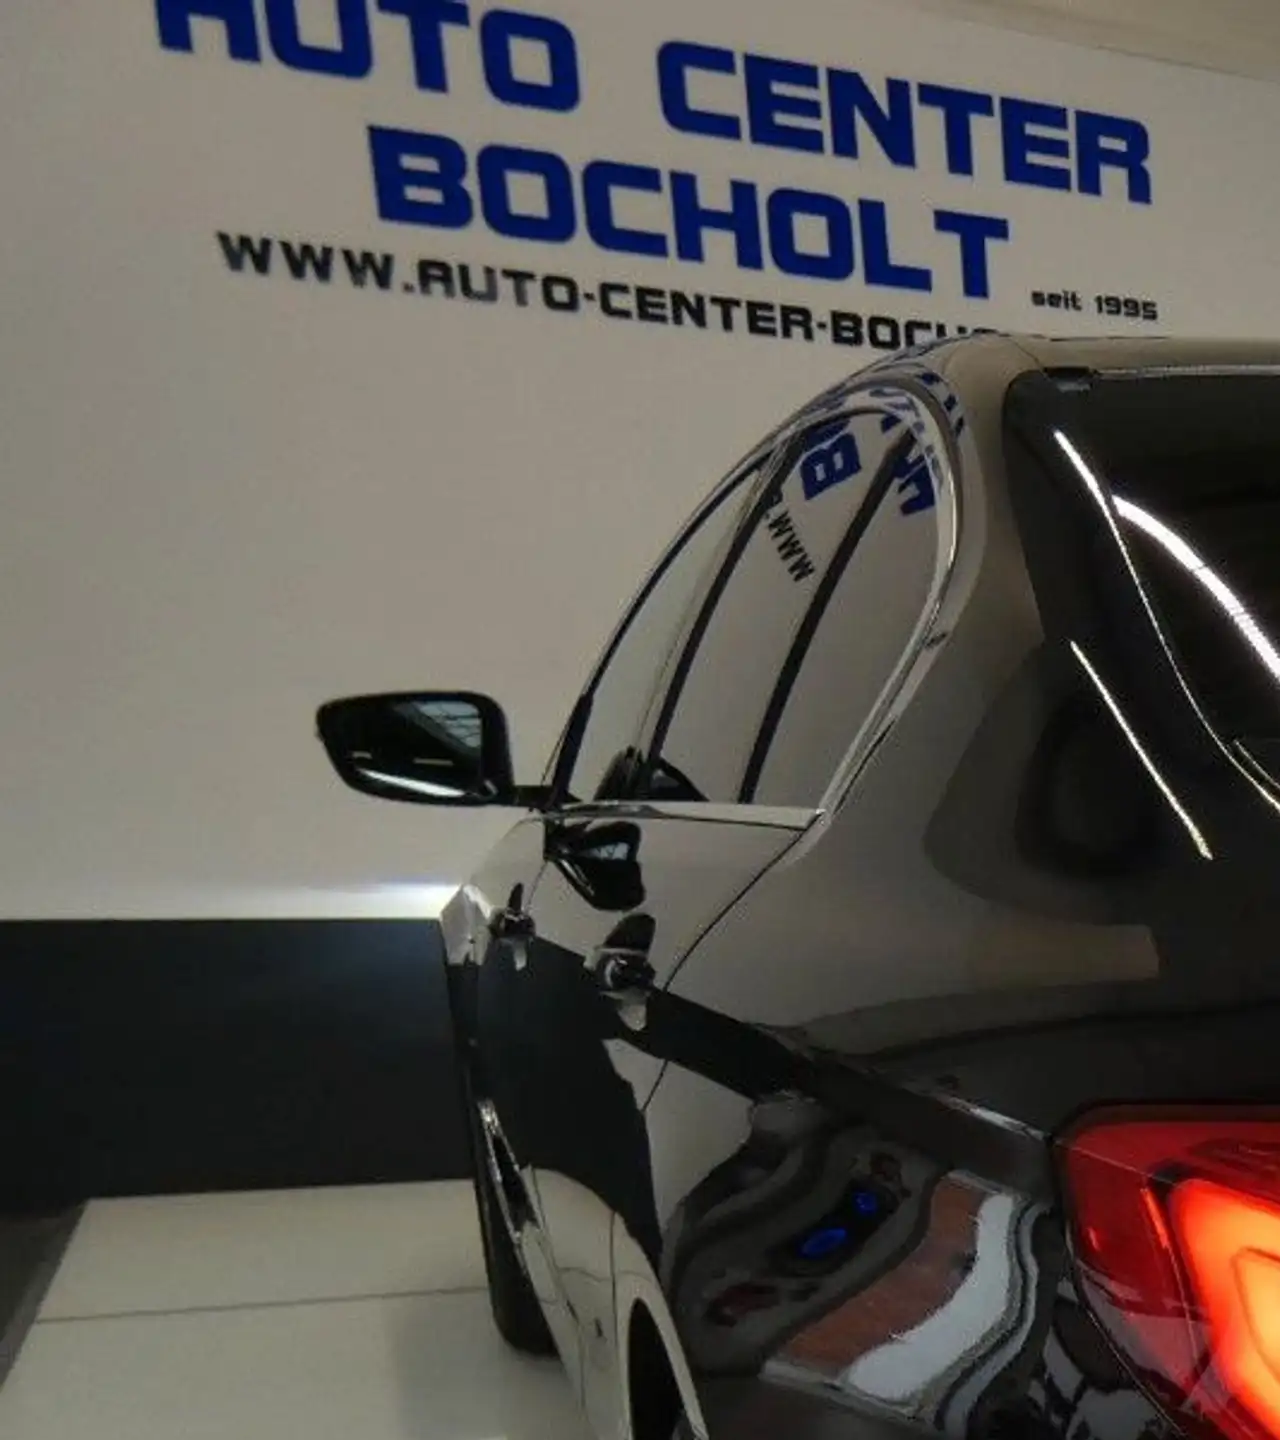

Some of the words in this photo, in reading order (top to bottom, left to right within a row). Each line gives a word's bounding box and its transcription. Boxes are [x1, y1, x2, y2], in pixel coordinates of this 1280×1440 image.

[157, 0, 579, 112] AUTO
[658, 42, 1151, 203] CENTER
[216, 231, 997, 350] WWW.AUTO-CENTER-BOC
[367, 126, 1008, 298] BOCHOLT
[1031, 290, 1083, 312] seit
[1093, 295, 1159, 321] 1995
